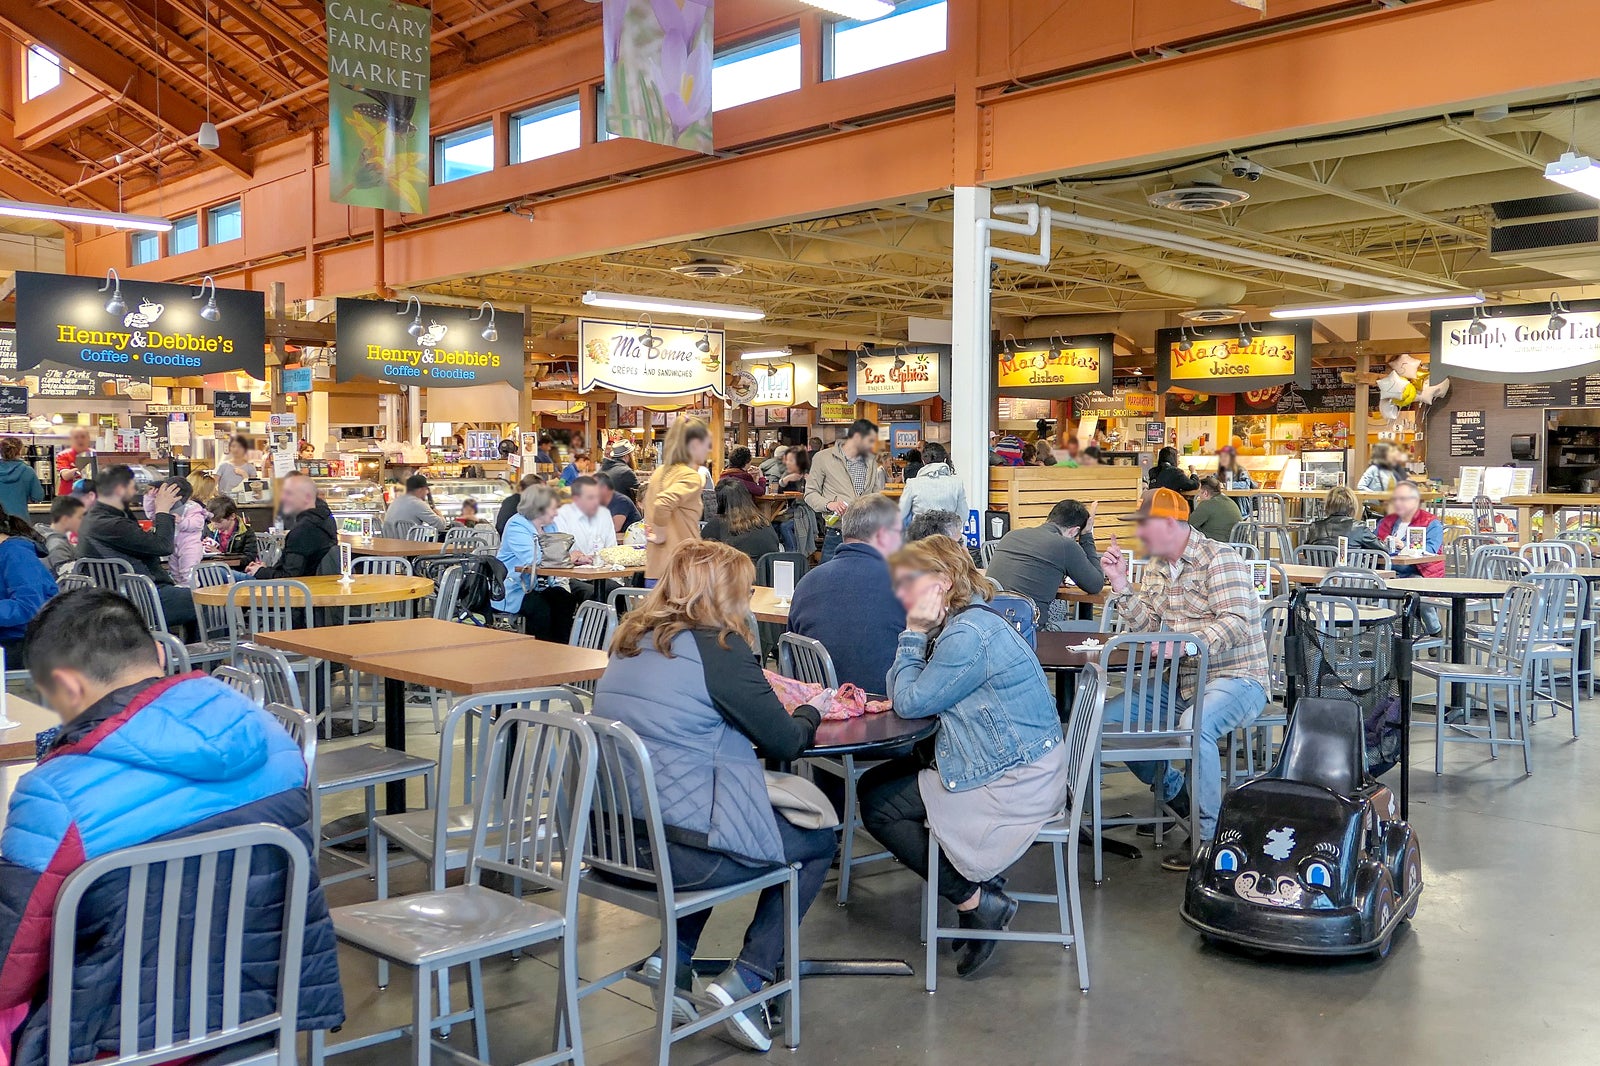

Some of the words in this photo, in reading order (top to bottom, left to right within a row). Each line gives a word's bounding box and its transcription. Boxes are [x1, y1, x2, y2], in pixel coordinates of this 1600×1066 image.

[328, 2, 426, 39] CALGARY
[329, 26, 428, 63] FARMERS'
[330, 55, 426, 91] MARKET
[56, 324, 234, 353] Henry&Debbie's
[1450, 328, 1507, 348] Simply
[1515, 324, 1561, 342] Good
[80, 348, 129, 363] Coffee
[143, 351, 202, 367] Goodies
[366, 344, 501, 367] Henry&Debbie's
[611, 335, 640, 358] Ma
[645, 336, 693, 361] Bonne
[45, 369, 63, 378] The
[383, 364, 421, 377] Coffee
[431, 367, 476, 380] Goodies
[643, 366, 656, 376] AND
[658, 368, 693, 378] SANDWICHES
[864, 367, 885, 384] Los
[1029, 370, 1065, 384] dishes
[1209, 360, 1250, 375] Juices
